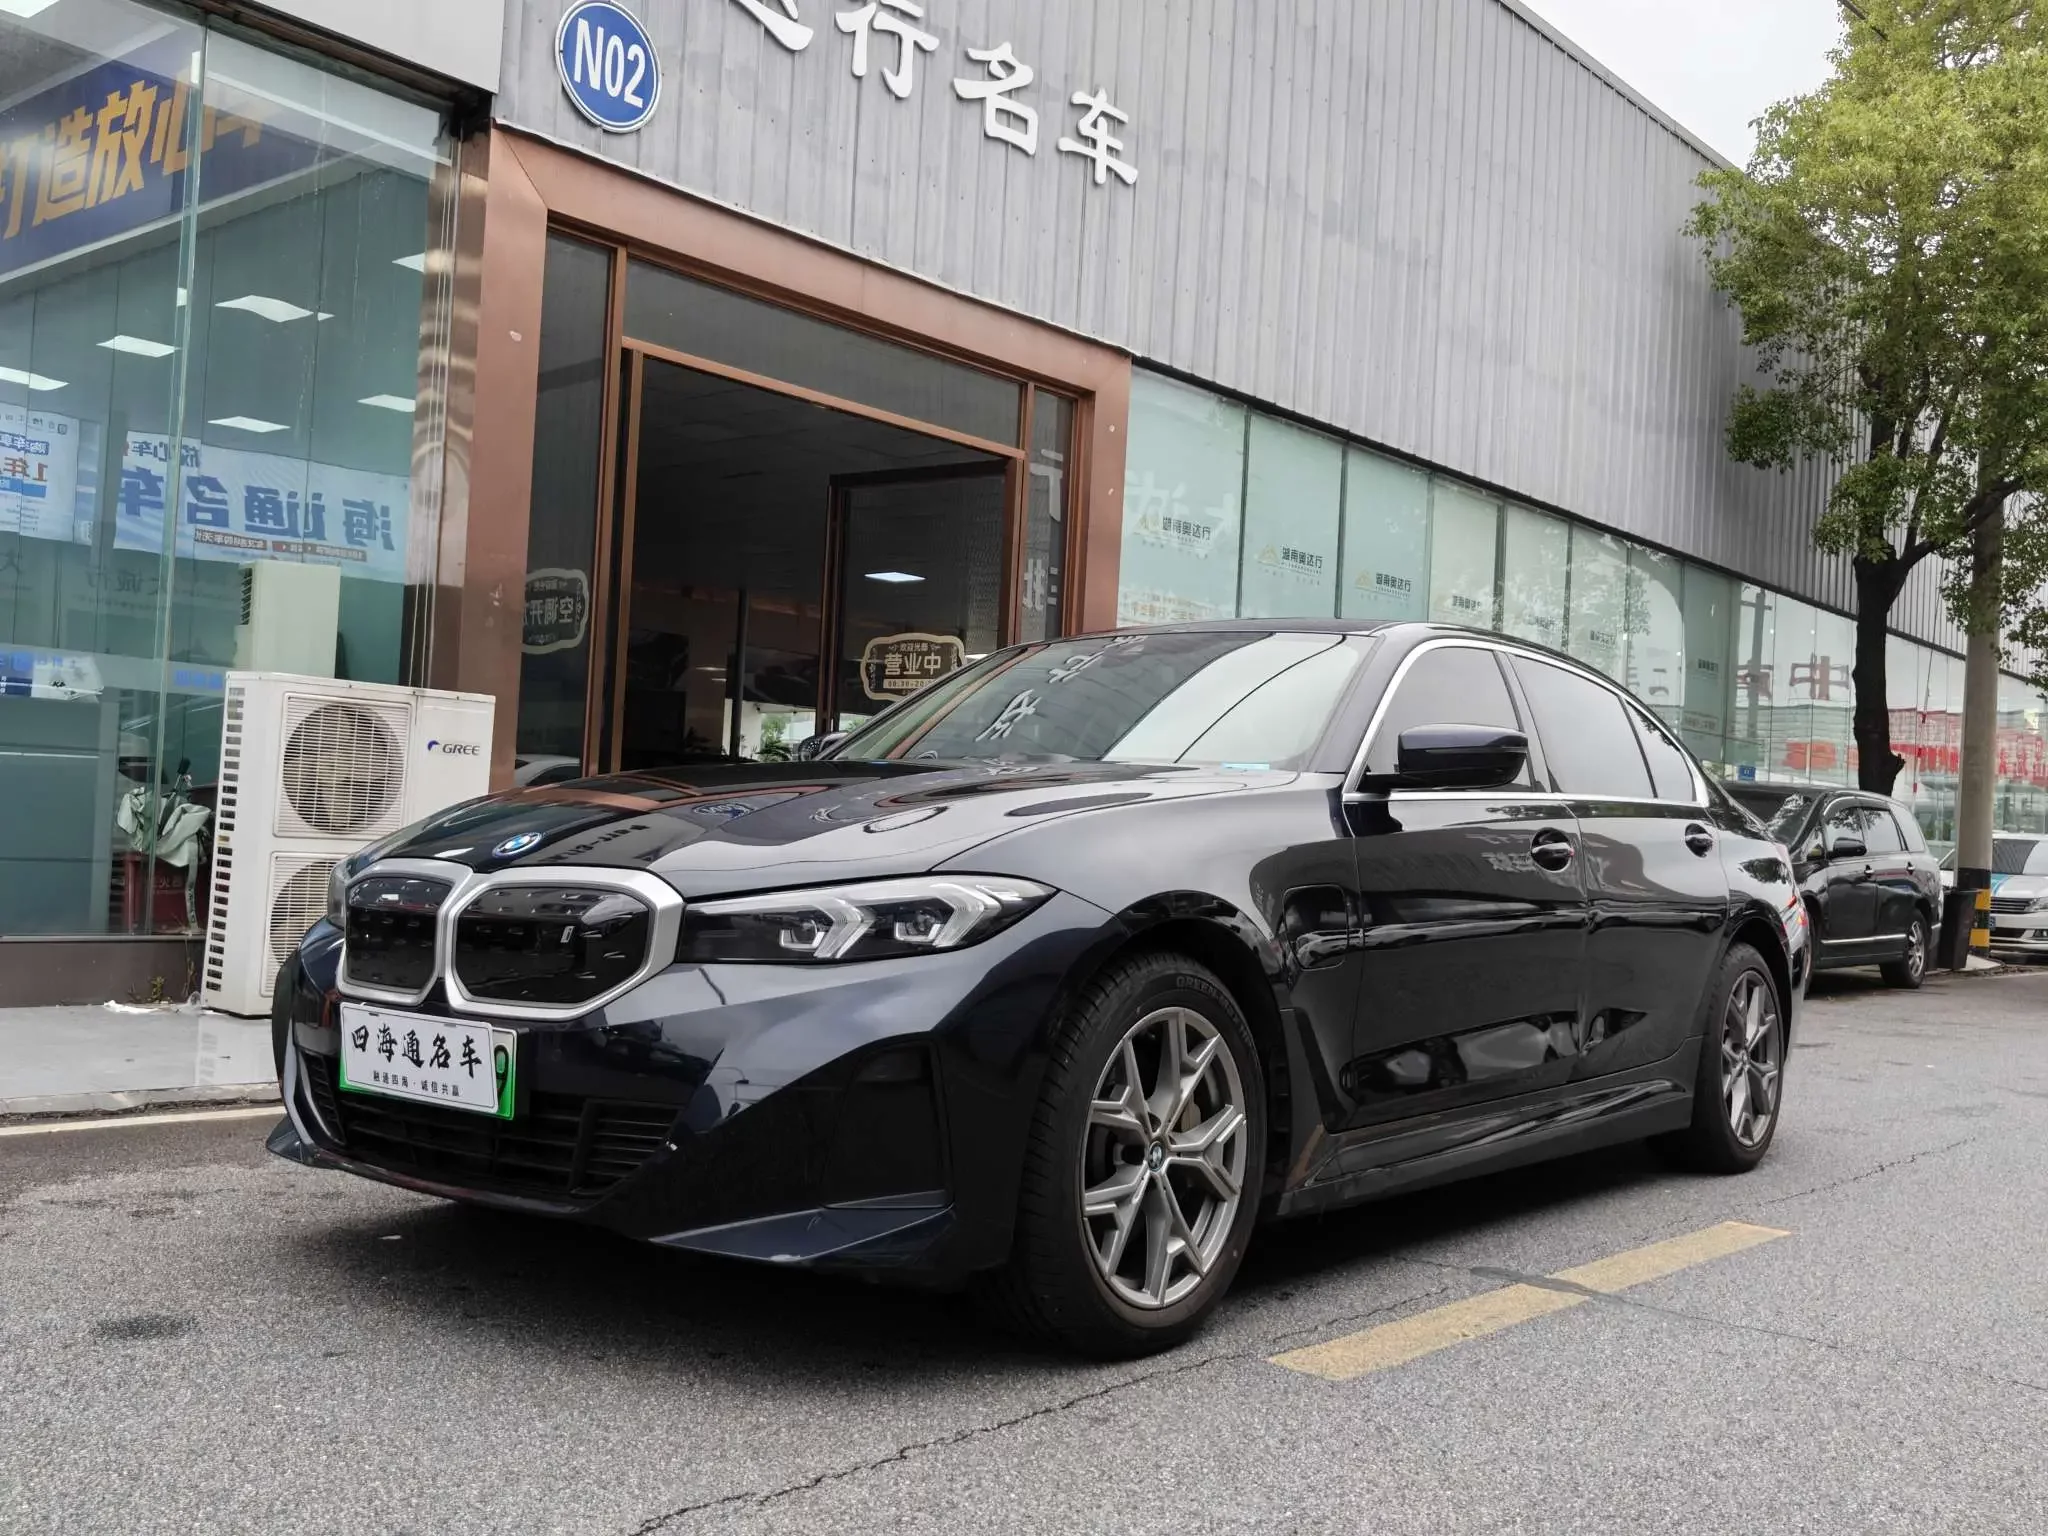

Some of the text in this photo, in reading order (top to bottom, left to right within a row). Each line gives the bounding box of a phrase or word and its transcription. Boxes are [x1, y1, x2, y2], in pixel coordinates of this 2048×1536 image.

[574, 17, 645, 109] N02
[884, 652, 942, 676] 营业中
[442, 743, 481, 756] GREE
[351, 1023, 483, 1079] 四海通名车
